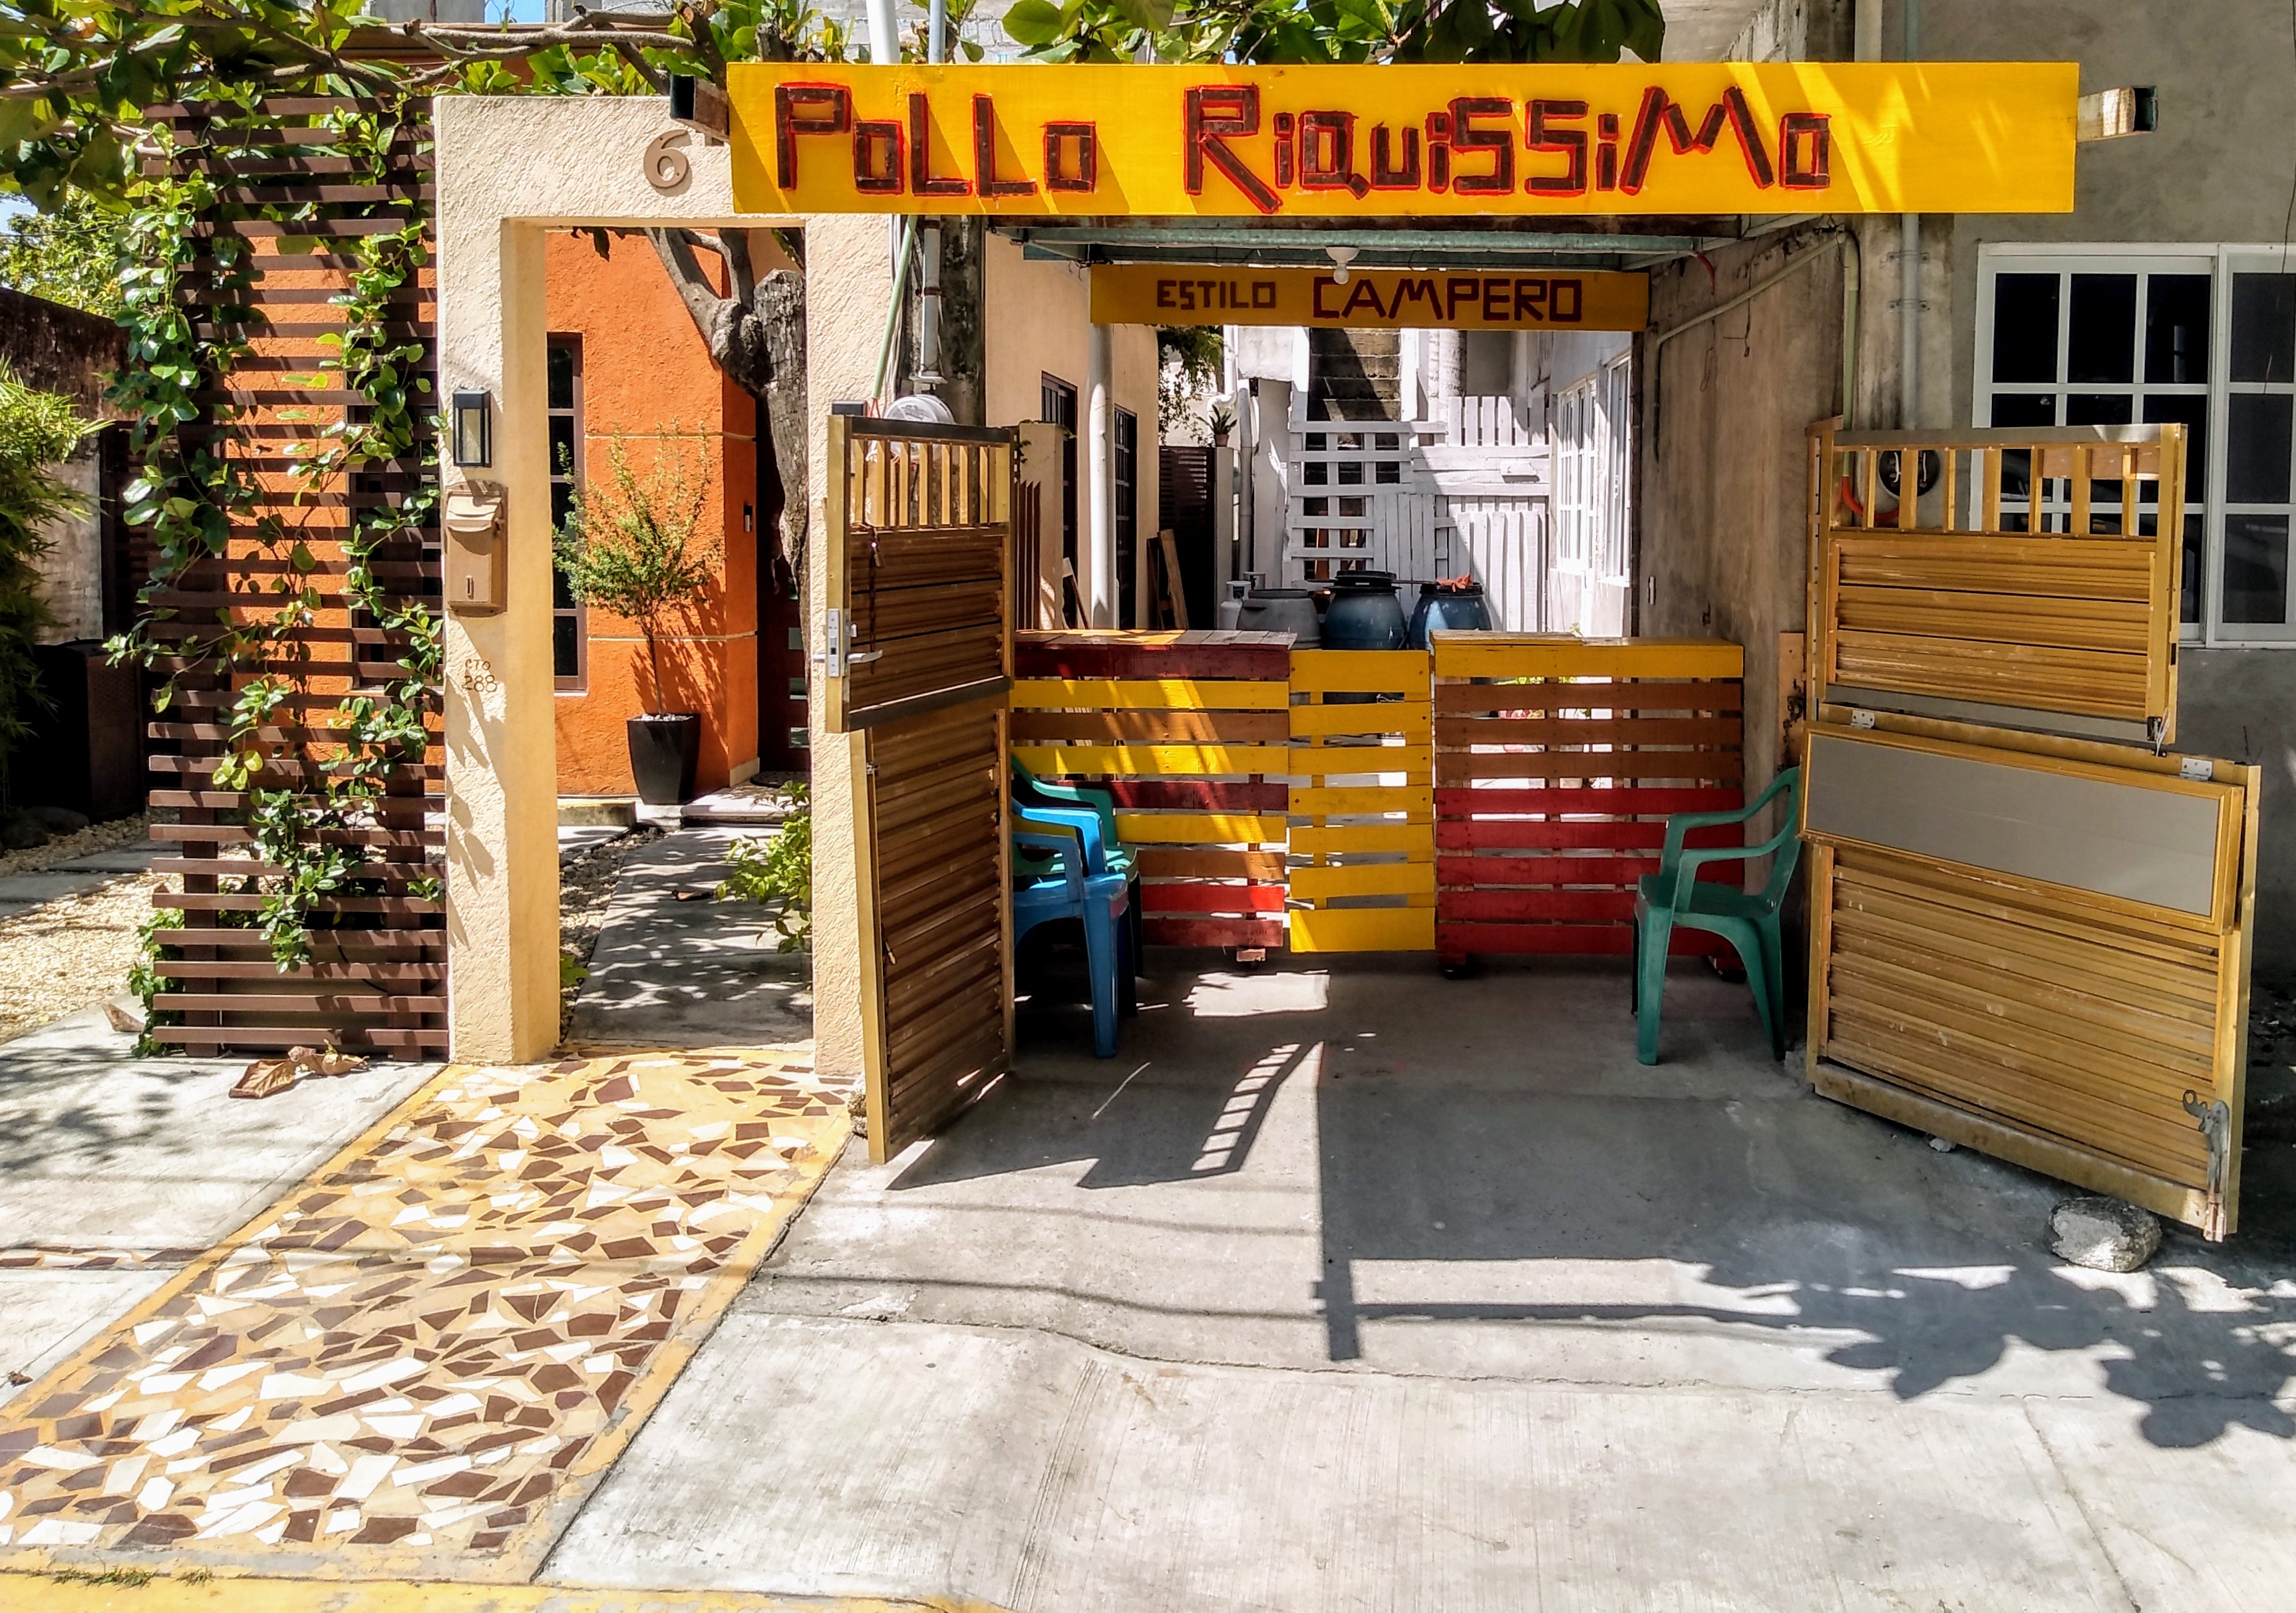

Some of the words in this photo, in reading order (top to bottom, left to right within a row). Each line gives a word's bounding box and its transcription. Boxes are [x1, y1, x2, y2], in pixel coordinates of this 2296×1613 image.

[643, 129, 689, 189] 6
[1156, 279, 1276, 311] ESTILO
[1313, 276, 1582, 323] CAMPERO
[462, 674, 498, 692] 288
